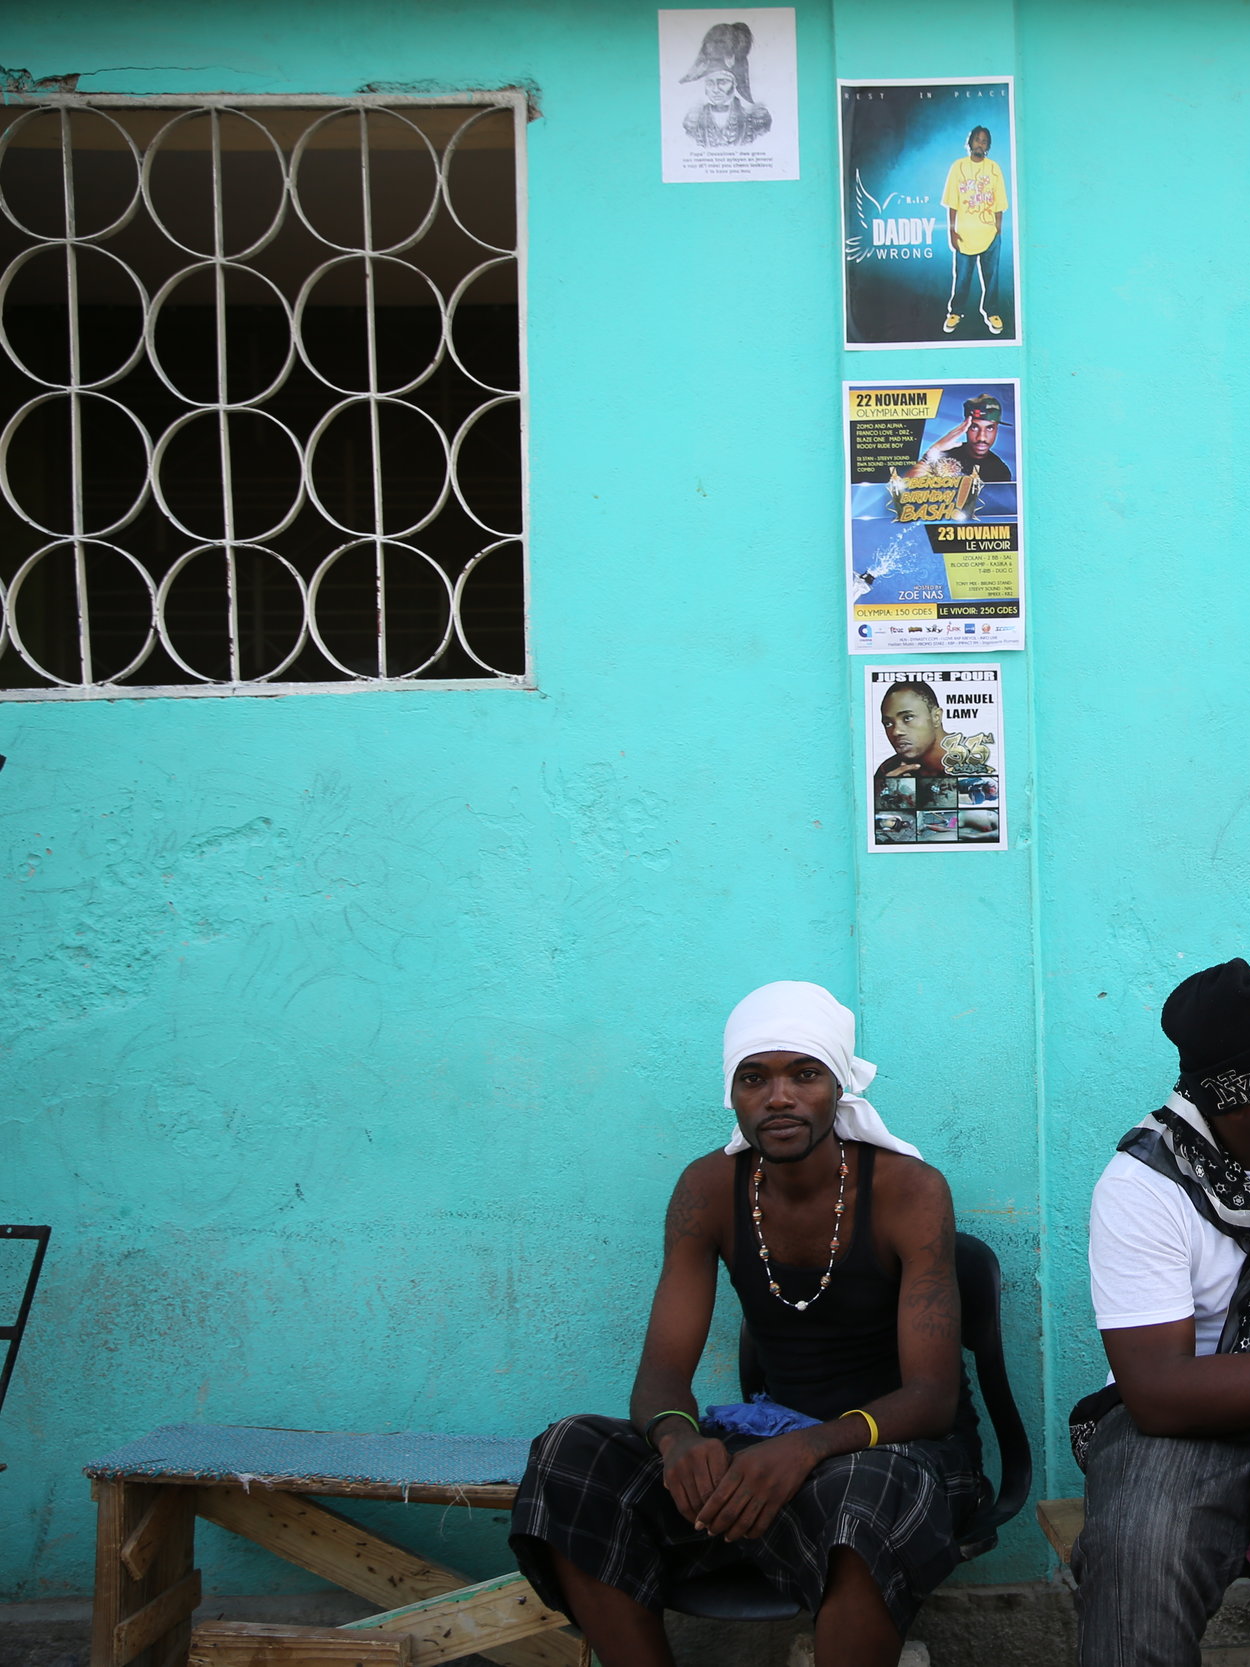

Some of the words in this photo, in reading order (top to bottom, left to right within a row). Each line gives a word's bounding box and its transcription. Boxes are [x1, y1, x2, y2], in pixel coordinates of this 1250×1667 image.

[954, 90, 1005, 98] PEACE
[872, 218, 936, 246] DADDY
[876, 248, 933, 259] WRONG
[857, 394, 872, 407] 22
[875, 393, 927, 406] NOVANM
[857, 408, 899, 418] OLYMPIA
[901, 408, 930, 416] NIGHT
[900, 490, 956, 504] BIRTHDAY
[938, 527, 954, 541] 23
[957, 526, 1010, 540] NOVANM
[966, 542, 976, 550] LE
[979, 541, 1011, 550] VIVOIR
[899, 591, 920, 600] ZOE
[923, 590, 944, 599] NAS
[912, 608, 933, 616] GDES
[950, 607, 978, 615] VIVOIR:
[980, 607, 995, 615] 250
[876, 672, 943, 682] JUSTICE
[950, 671, 995, 681] POUR
[946, 694, 994, 704] MANUEL
[946, 709, 979, 719] LAMY
